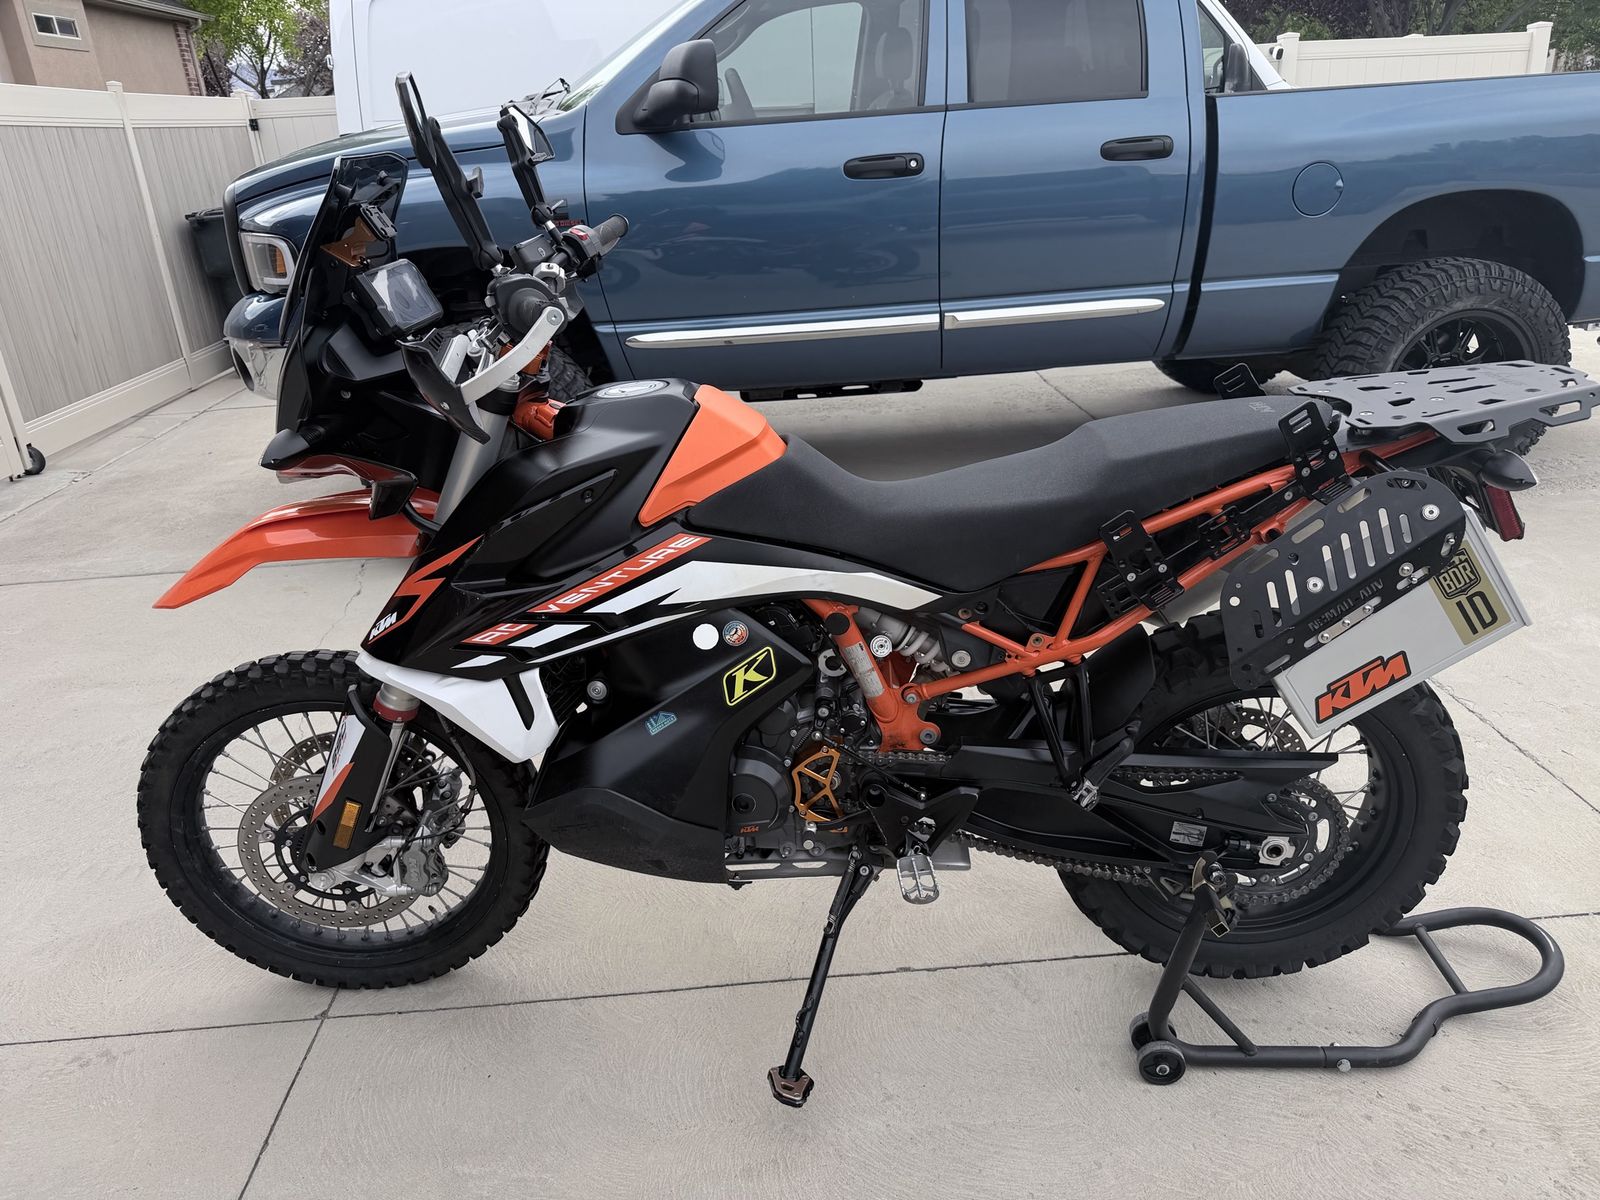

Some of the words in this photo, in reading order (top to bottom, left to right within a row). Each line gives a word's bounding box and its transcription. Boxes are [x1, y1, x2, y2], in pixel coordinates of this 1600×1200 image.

[1439, 561, 1476, 593] BDR
[369, 611, 397, 640] KTM
[1317, 653, 1409, 722] KTM
